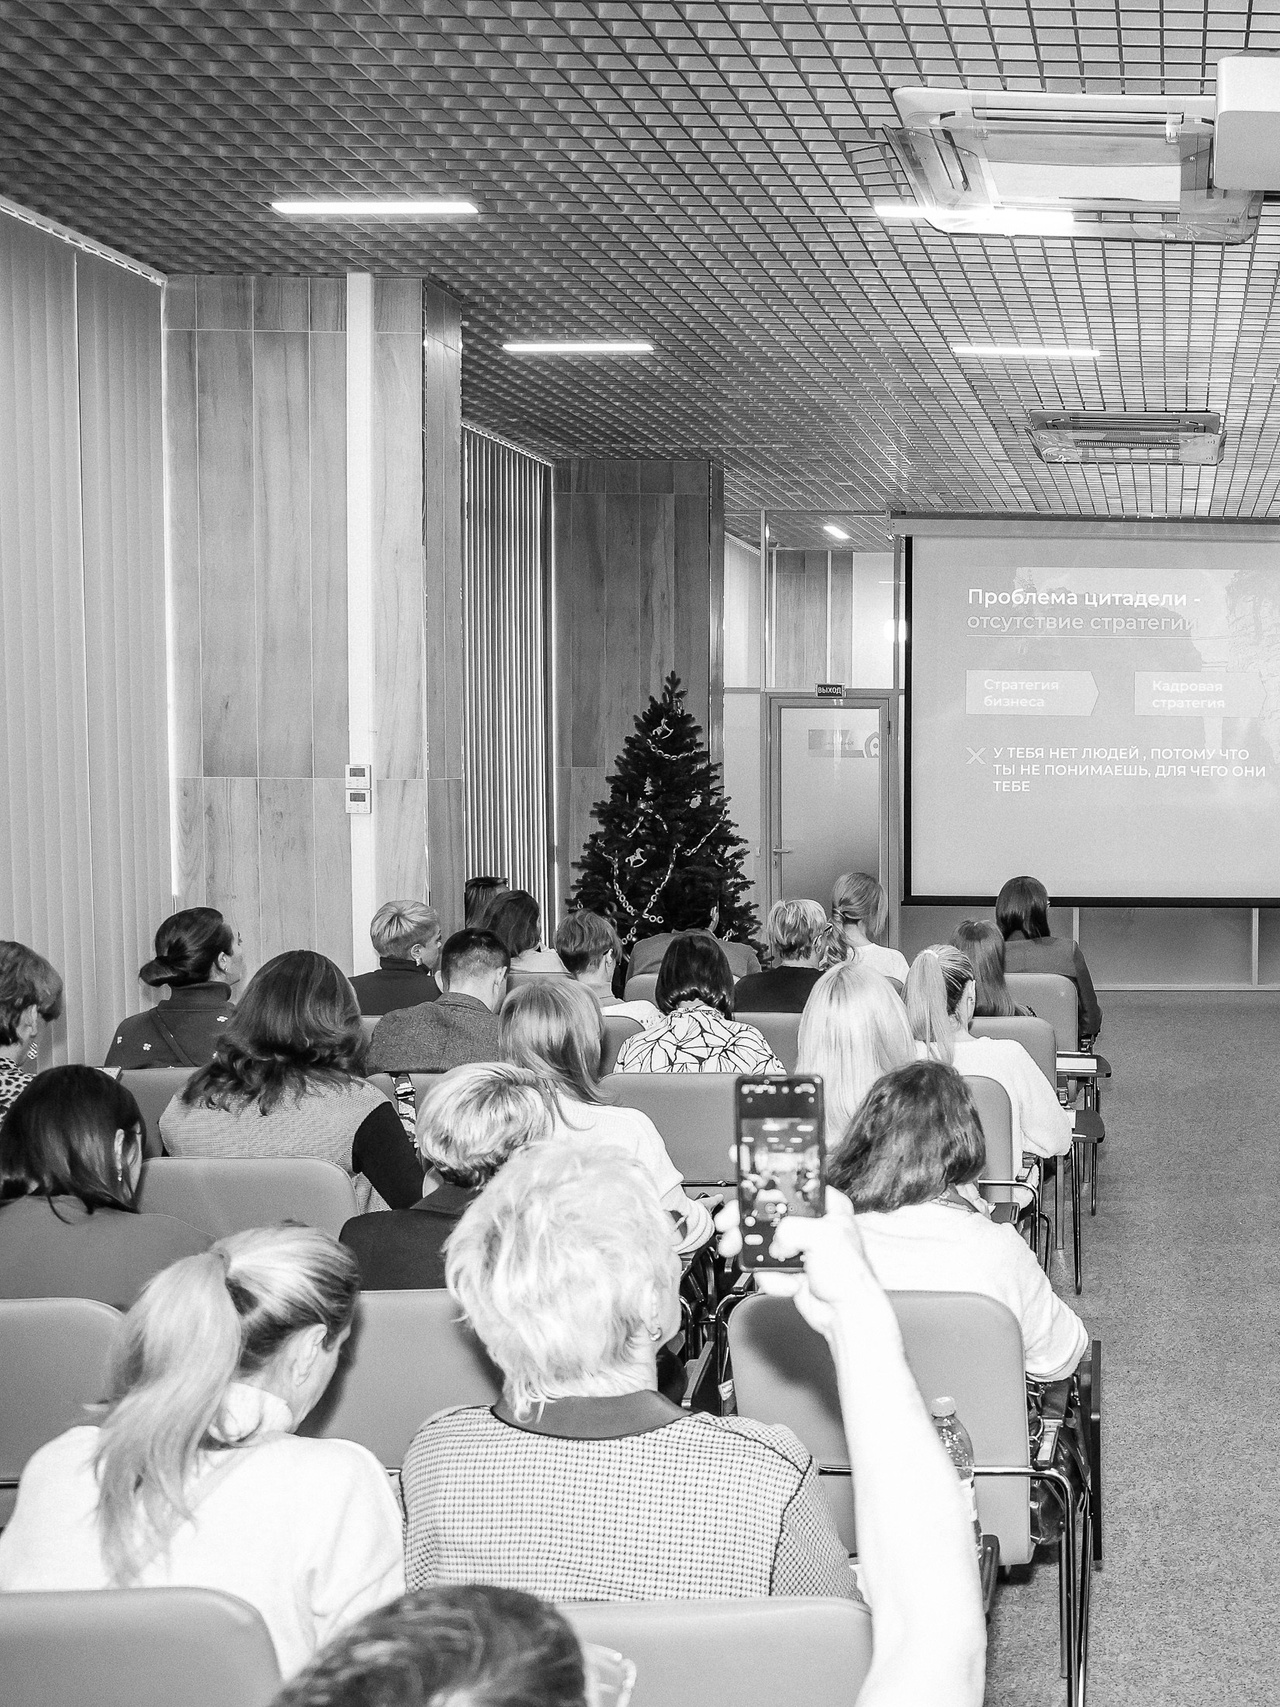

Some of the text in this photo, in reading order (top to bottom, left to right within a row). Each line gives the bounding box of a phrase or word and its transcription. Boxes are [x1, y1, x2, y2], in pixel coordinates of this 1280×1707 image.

[969, 589, 1078, 607] Проблема
[1084, 592, 1186, 607] цитадели
[967, 615, 1198, 633] отсутствие стратегии
[984, 679, 1059, 691] Стратегия
[1152, 680, 1223, 693] Кадровая
[984, 695, 1045, 707] бизнеса
[1152, 698, 1225, 710] стратегия
[993, 748, 1003, 759] У
[1008, 748, 1044, 759] ТЕБЯ
[1049, 748, 1077, 759] НЕТ
[1081, 746, 1139, 761] ЛЮДЕЙ
[1151, 749, 1215, 760] ПОТОМУ
[1220, 749, 1249, 760] ЧТО
[993, 765, 1266, 778] ТЫ НЕ ПОНИМАЕШЬ, ДЛЯ ЧЕГО ОНИ
[993, 781, 1030, 792] ТЕБЕ
